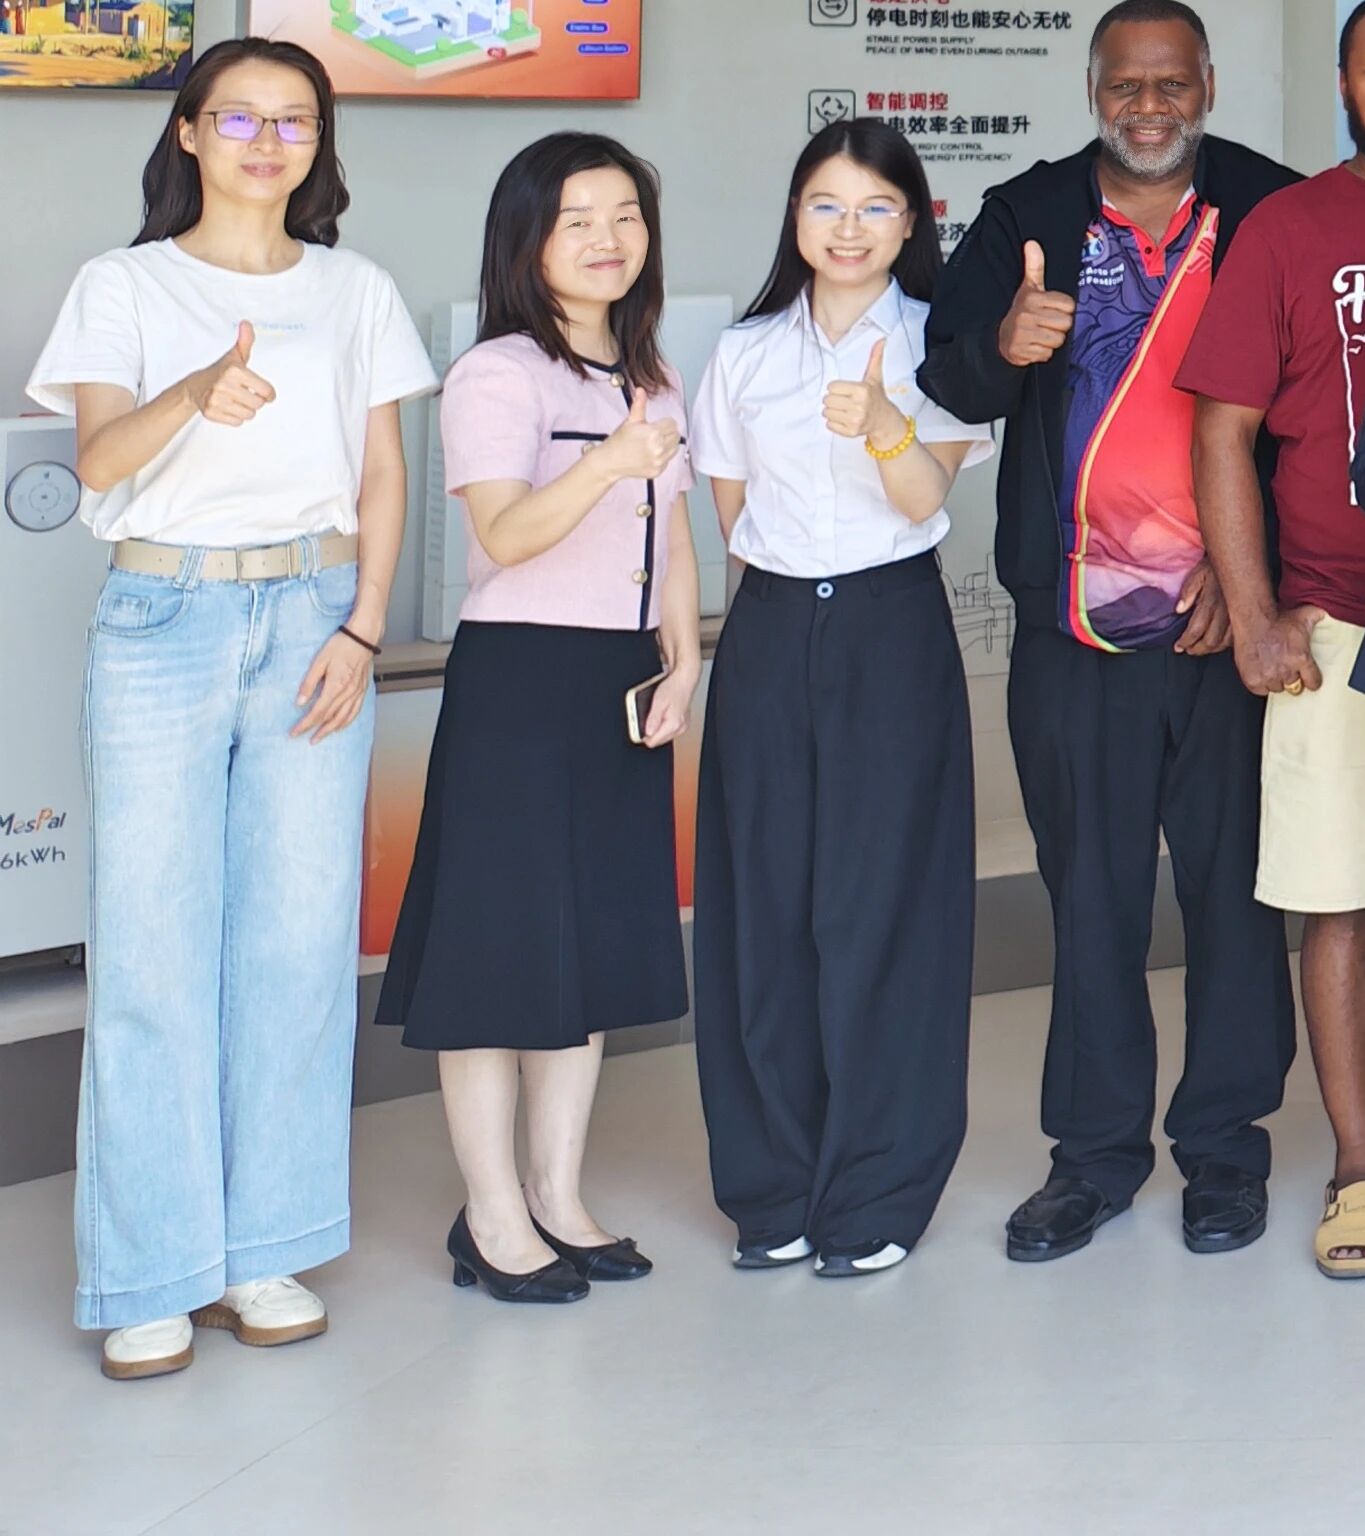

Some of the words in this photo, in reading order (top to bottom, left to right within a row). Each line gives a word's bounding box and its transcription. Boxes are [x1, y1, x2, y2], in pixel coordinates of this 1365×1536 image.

[867, 7, 1072, 30] 停电时刻也能安心无忧
[903, 36, 937, 44] POWER
[940, 36, 975, 44] SUPPLY
[866, 46, 896, 55] PEACE
[900, 47, 911, 55] OF
[914, 47, 938, 55] MIND
[1005, 48, 1048, 56] OUTAGES
[866, 92, 949, 112] 智能调控
[872, 115, 1031, 135] 电效率全面提升
[940, 142, 983, 151] CONTROL
